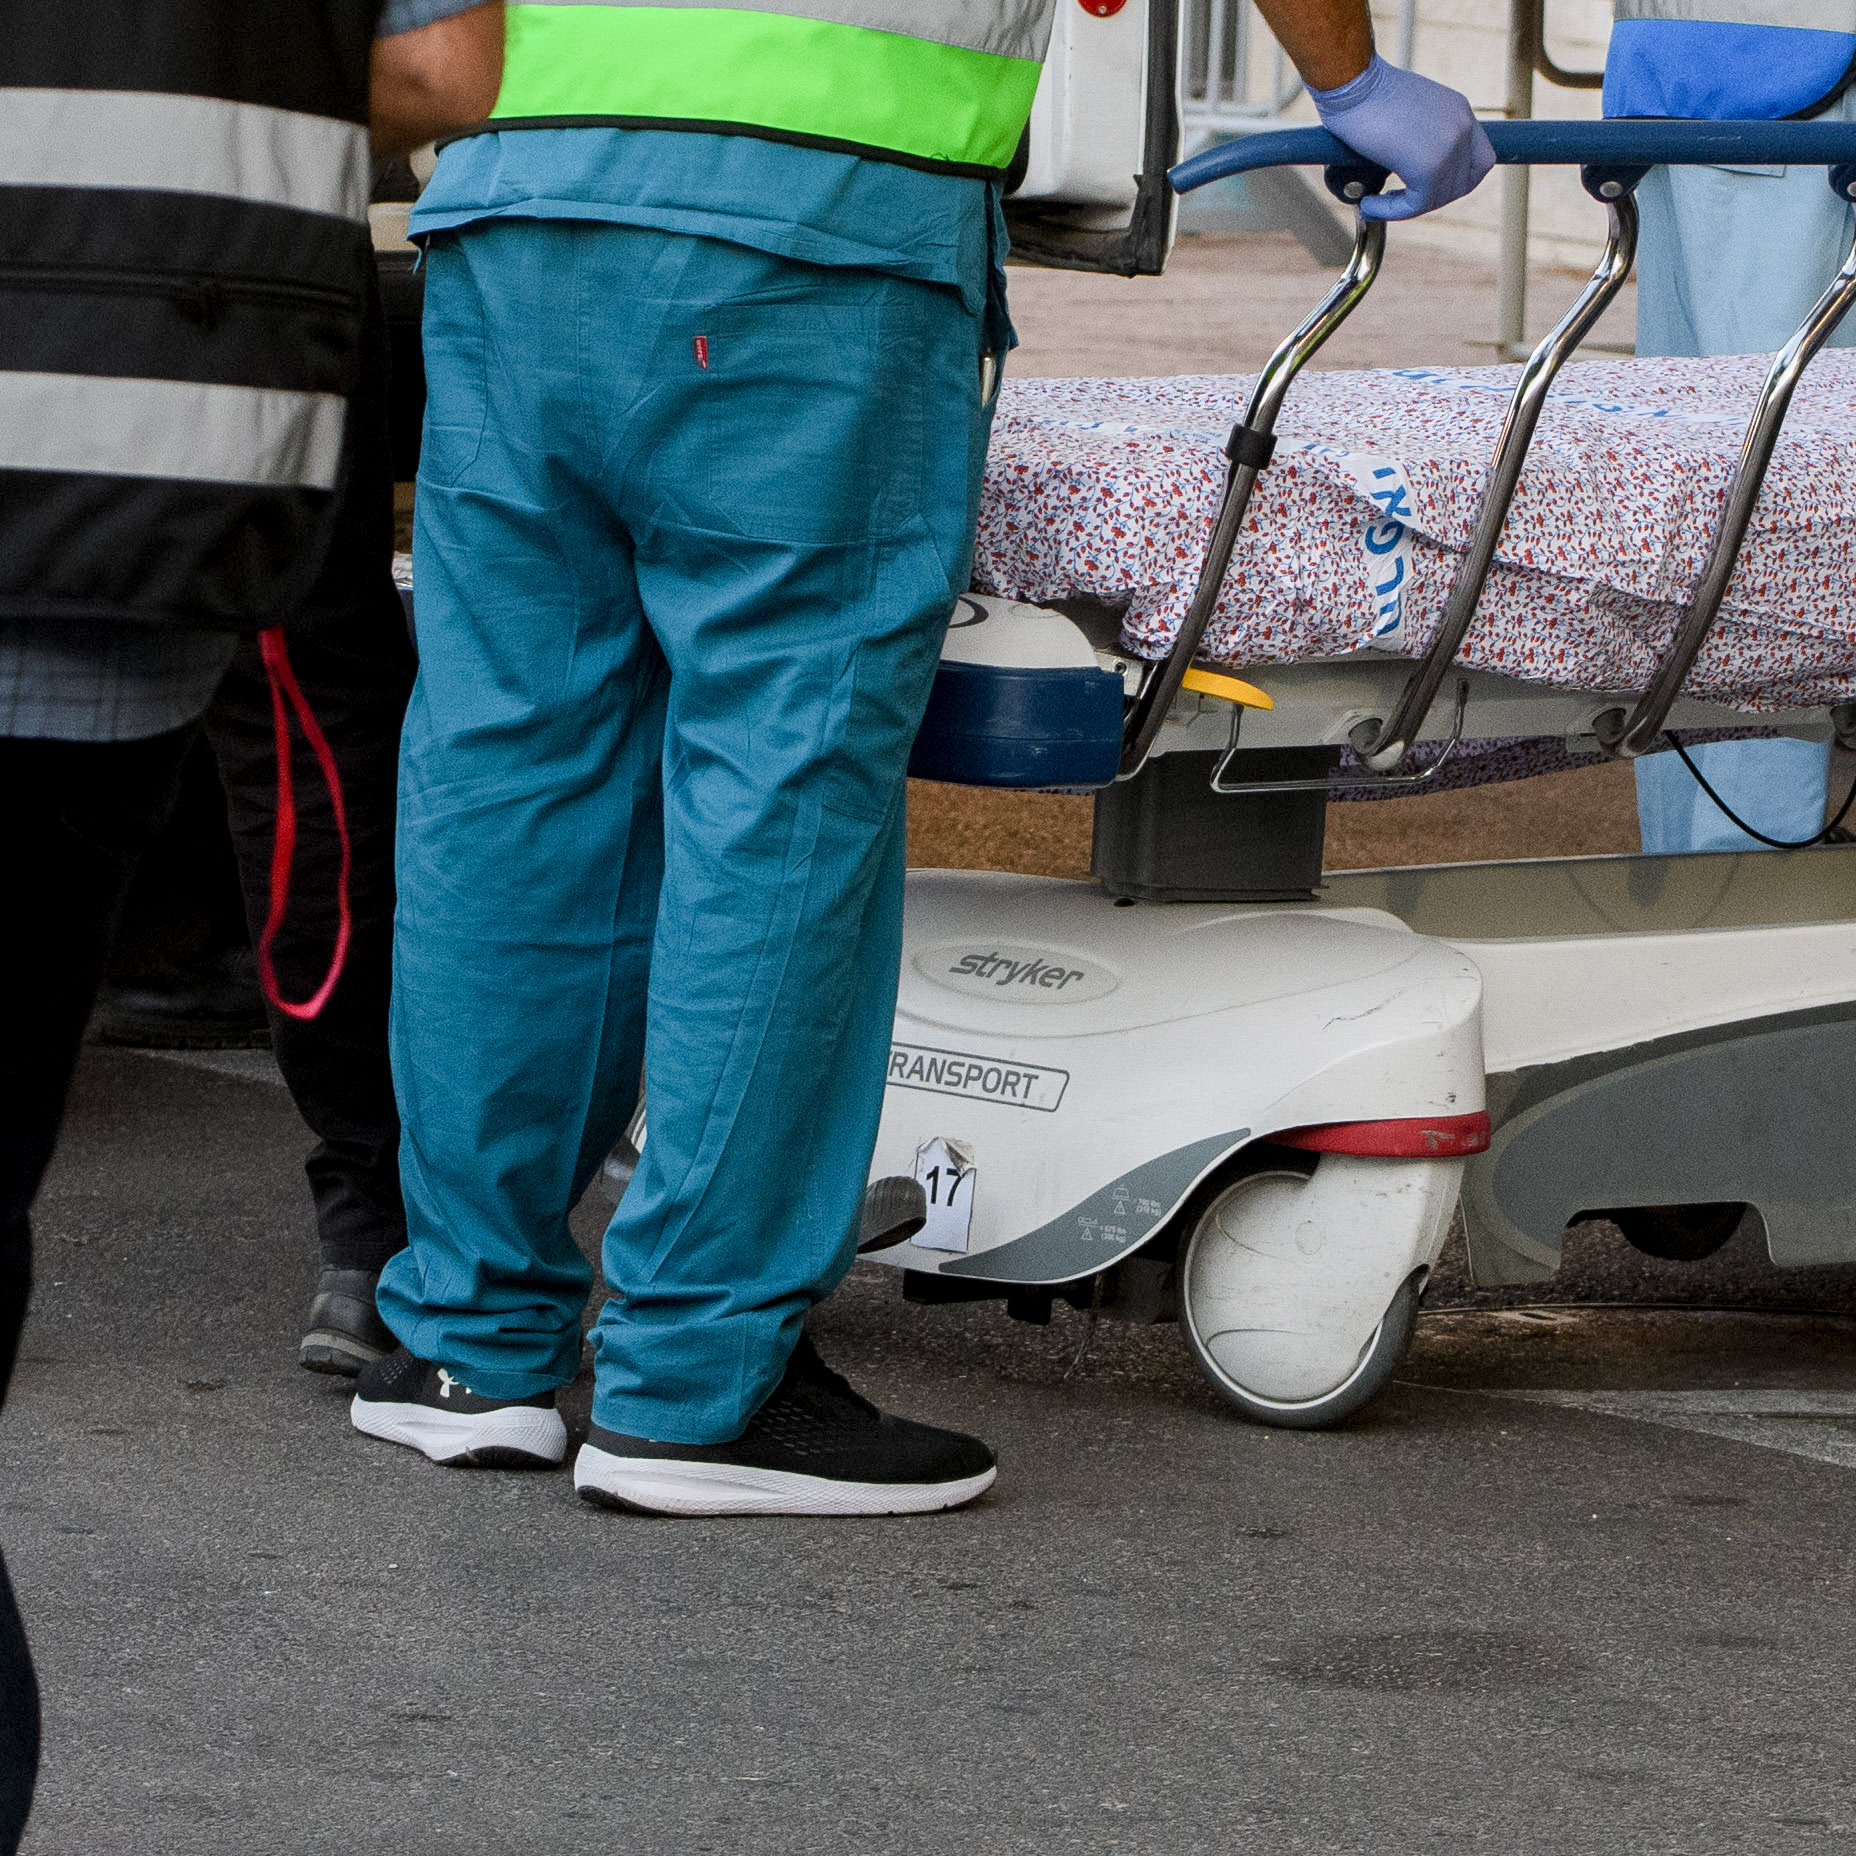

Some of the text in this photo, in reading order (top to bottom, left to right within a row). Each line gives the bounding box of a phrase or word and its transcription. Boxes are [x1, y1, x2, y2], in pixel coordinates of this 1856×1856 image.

[949, 952, 1085, 990] stryker
[887, 1050, 1040, 1099] RANSPORT
[926, 1165, 963, 1207] 17
